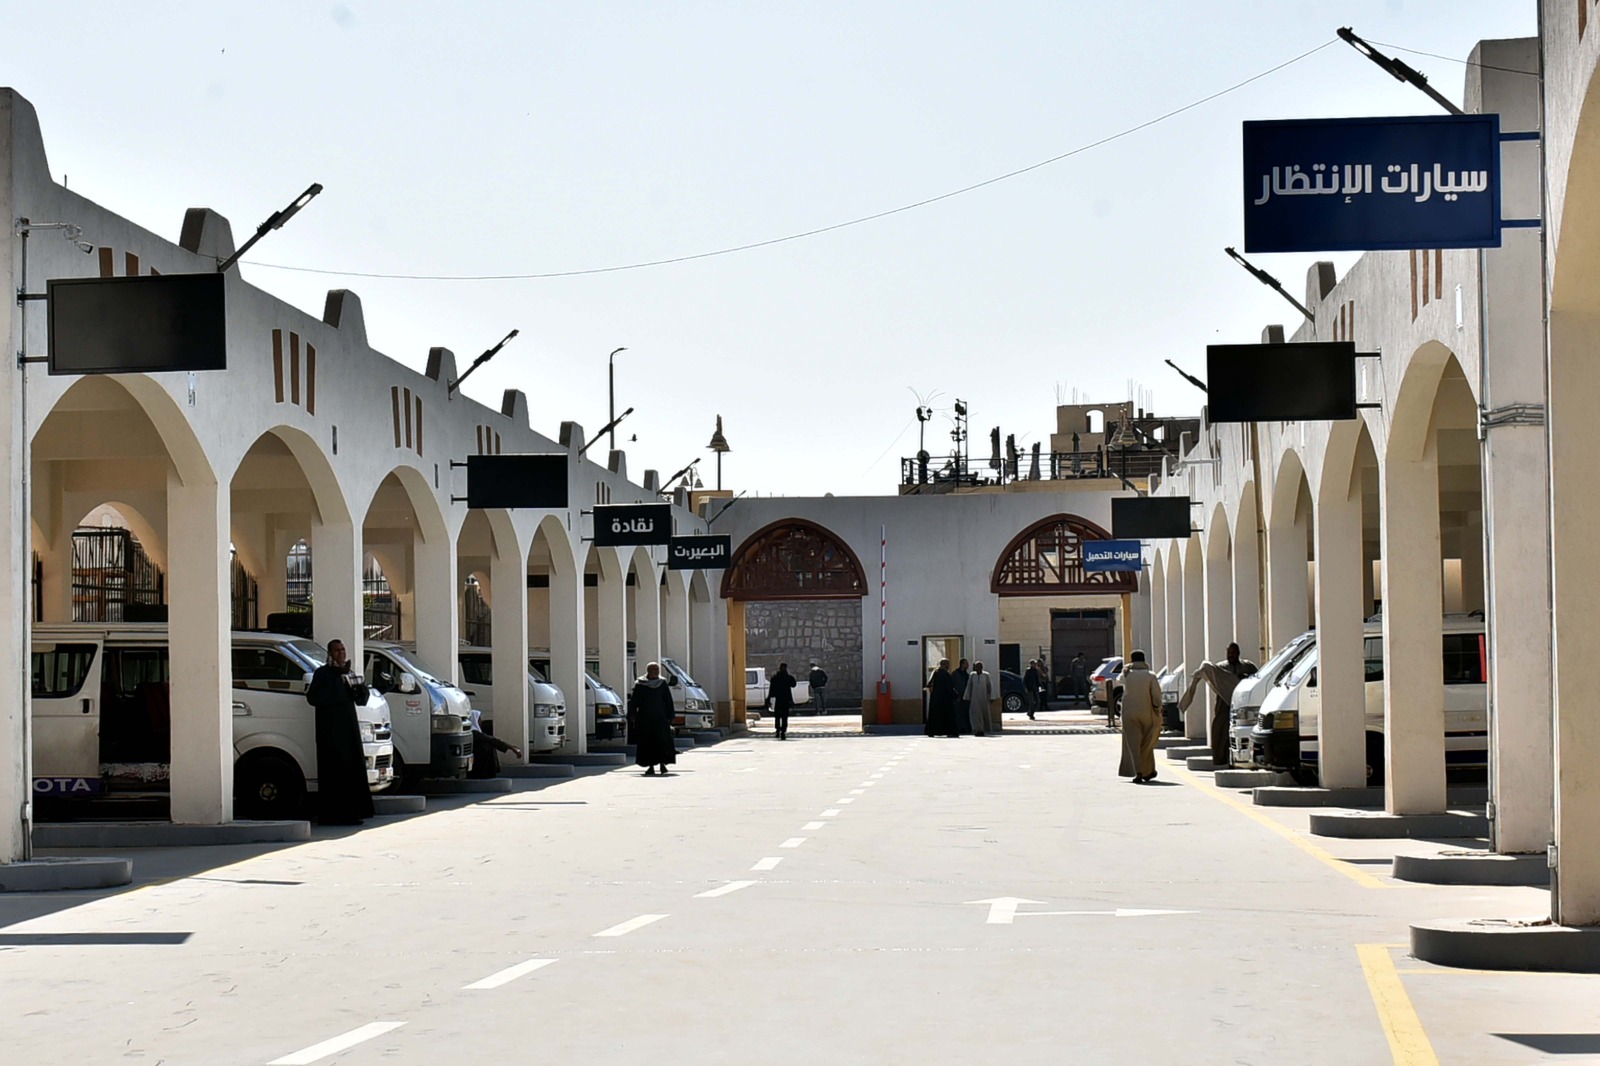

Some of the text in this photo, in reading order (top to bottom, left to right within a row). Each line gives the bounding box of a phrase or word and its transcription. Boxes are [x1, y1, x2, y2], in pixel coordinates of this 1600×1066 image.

[1254, 163, 1488, 205] سيارات الإنتظار
[611, 517, 654, 533] نقادة
[1085, 551, 1139, 562] سيارات التحميل
